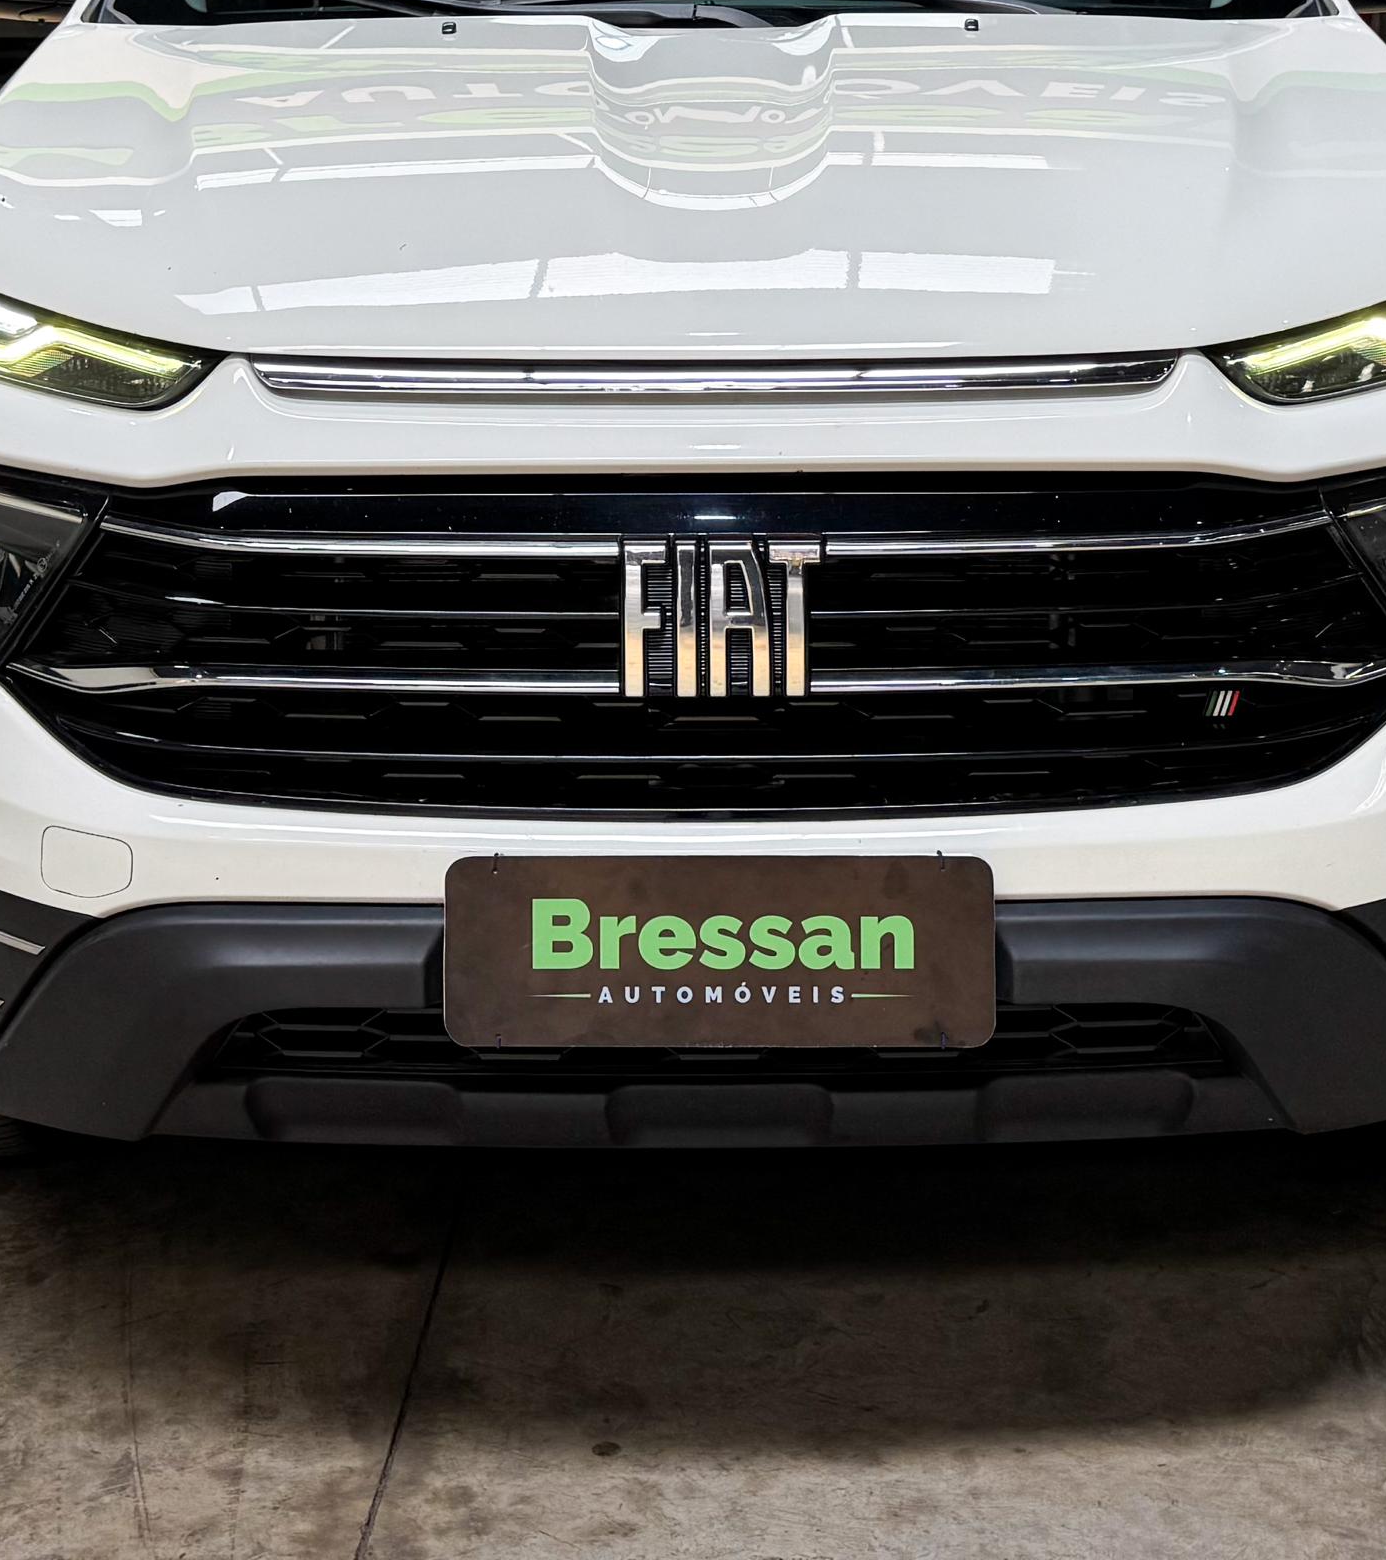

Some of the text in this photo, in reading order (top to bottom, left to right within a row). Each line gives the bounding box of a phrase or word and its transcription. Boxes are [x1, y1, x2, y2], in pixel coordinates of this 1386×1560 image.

[624, 541, 821, 697] FIAT
[531, 898, 915, 970] Bressan
[598, 981, 846, 1004] AUTOMÓVEIS
